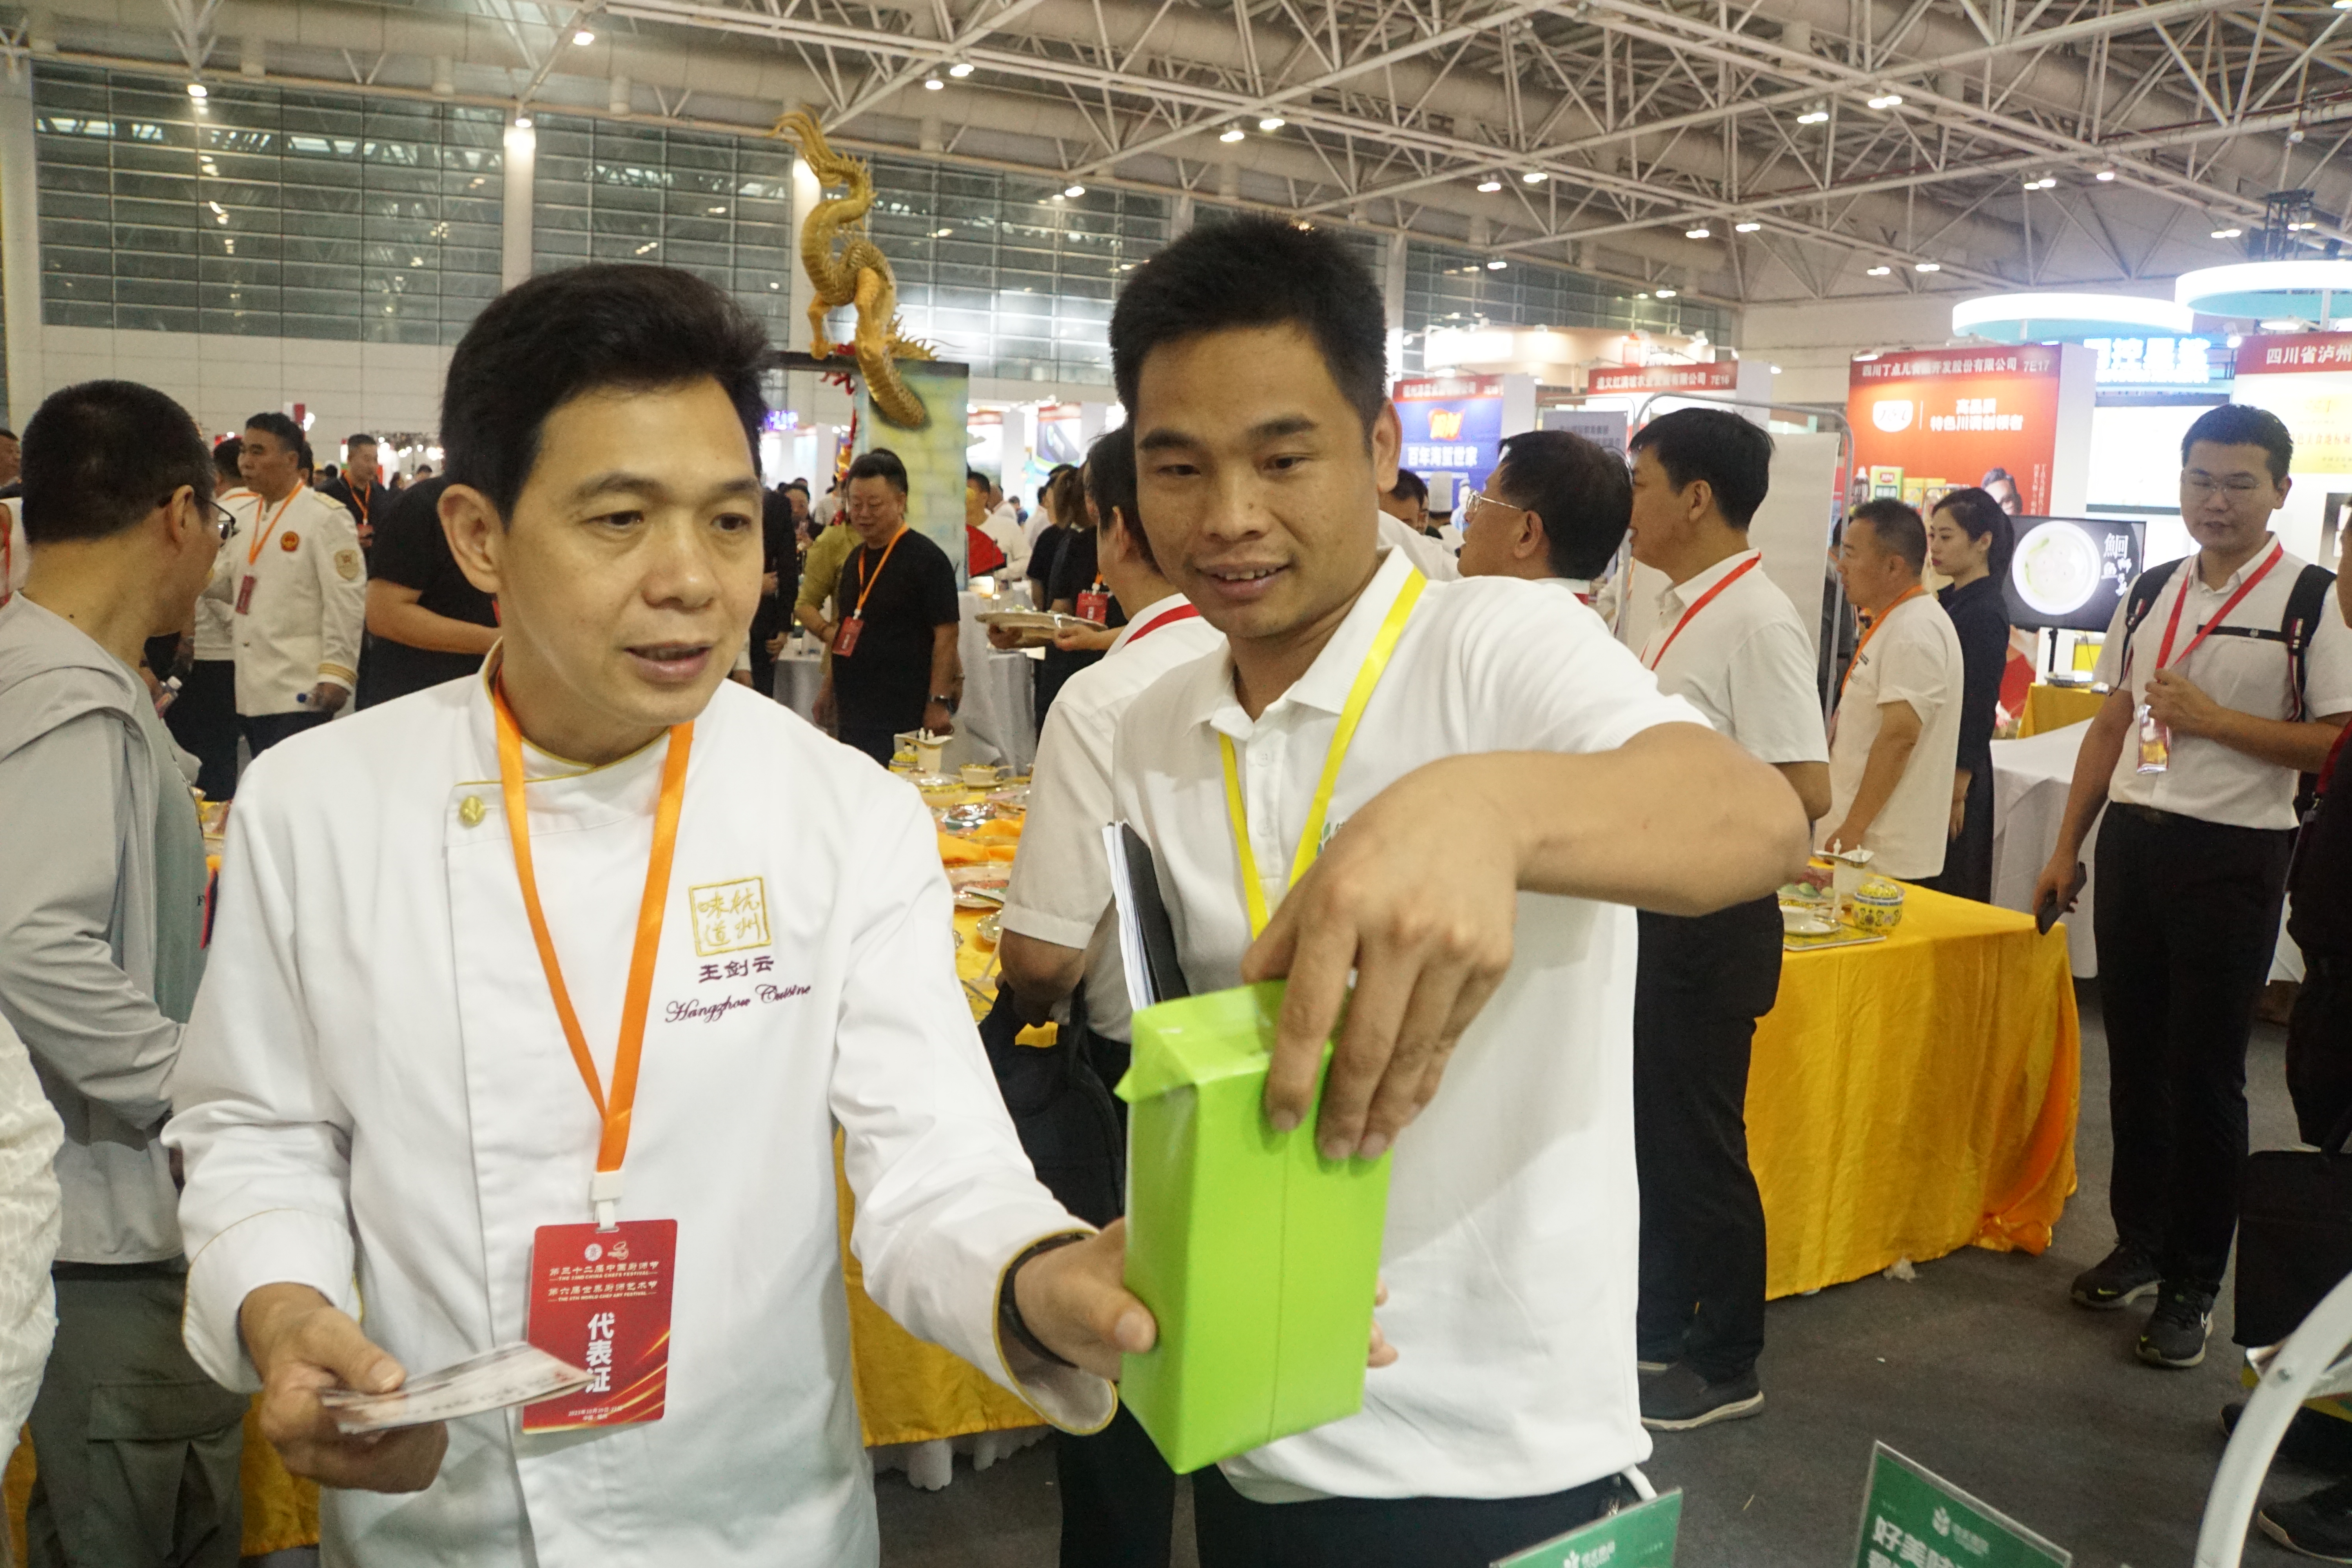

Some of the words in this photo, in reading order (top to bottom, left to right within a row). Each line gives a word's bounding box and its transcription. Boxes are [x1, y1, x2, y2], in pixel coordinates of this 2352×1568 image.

[2023, 359, 2050, 373] 7E17
[1956, 398, 1996, 415] 高品质
[699, 955, 774, 984] 王剑云
[665, 995, 751, 1024] Hangzhou
[755, 984, 811, 1003] Cuisine
[549, 1260, 659, 1277] 第三十二届中国厨师节
[548, 1280, 658, 1296] 第六届世界厨师艺术节
[585, 1311, 615, 1394] 代表证
